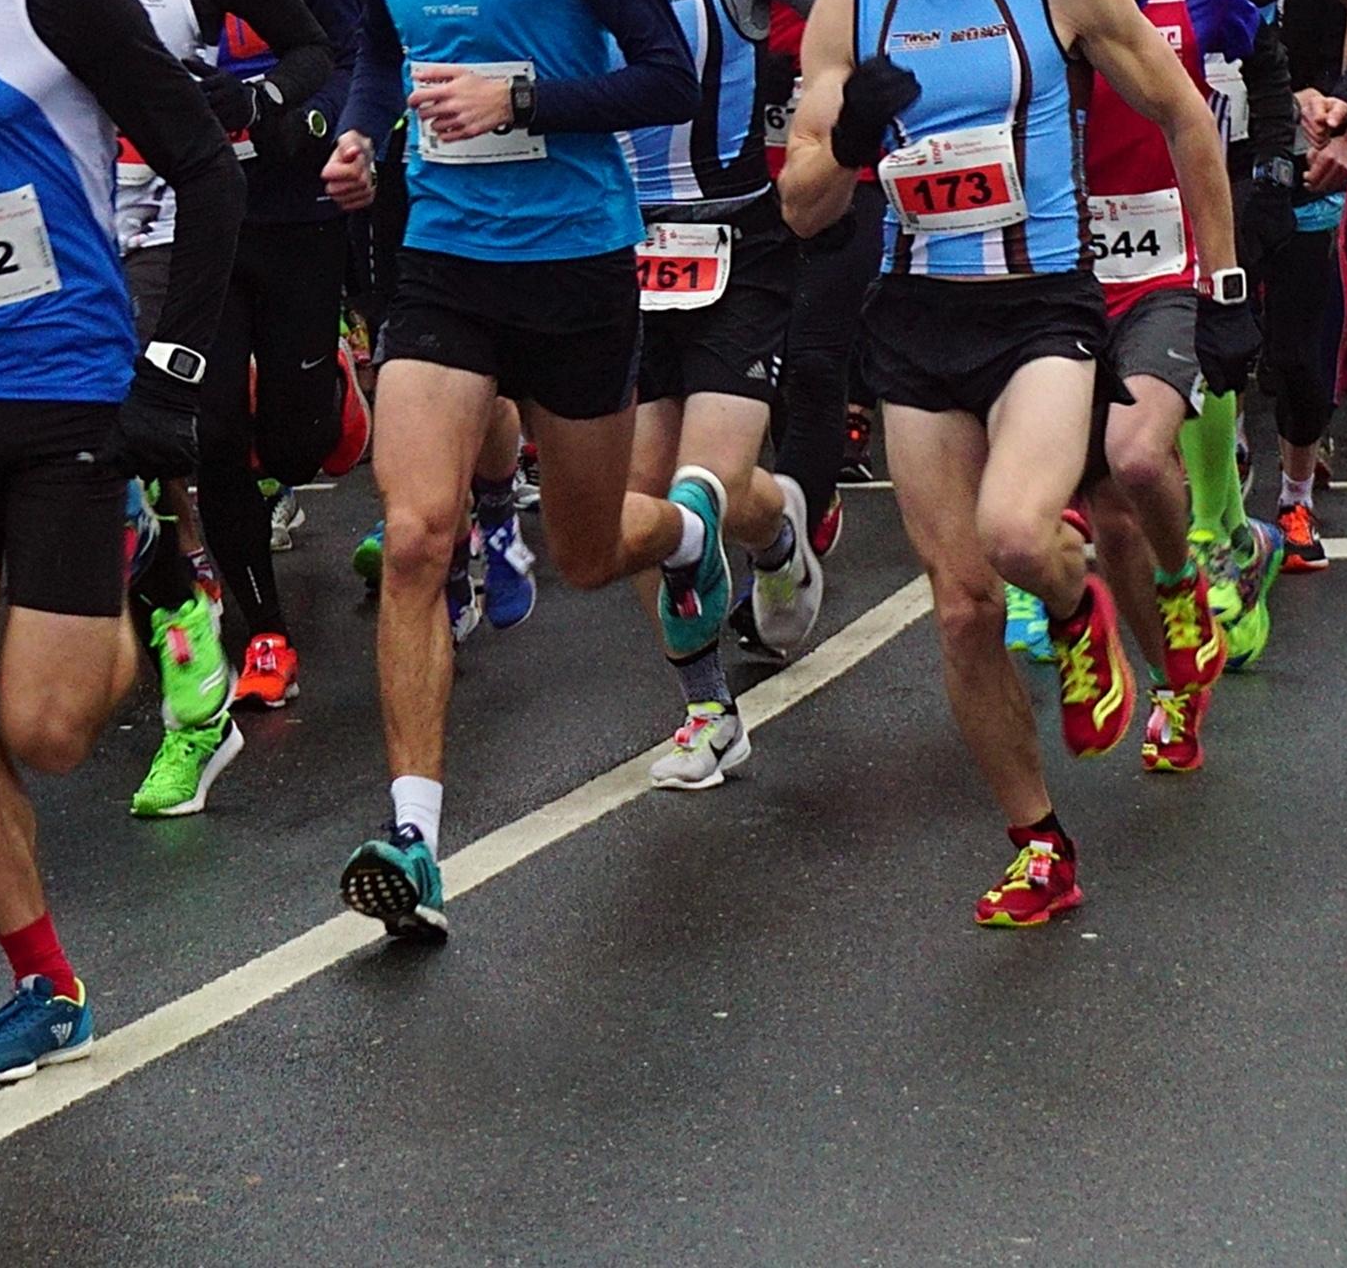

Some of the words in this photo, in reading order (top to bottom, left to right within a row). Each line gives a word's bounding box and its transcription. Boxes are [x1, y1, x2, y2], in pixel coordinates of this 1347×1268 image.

[914, 172, 992, 210] 173
[1091, 229, 1161, 259] 544
[637, 260, 699, 289] 161
